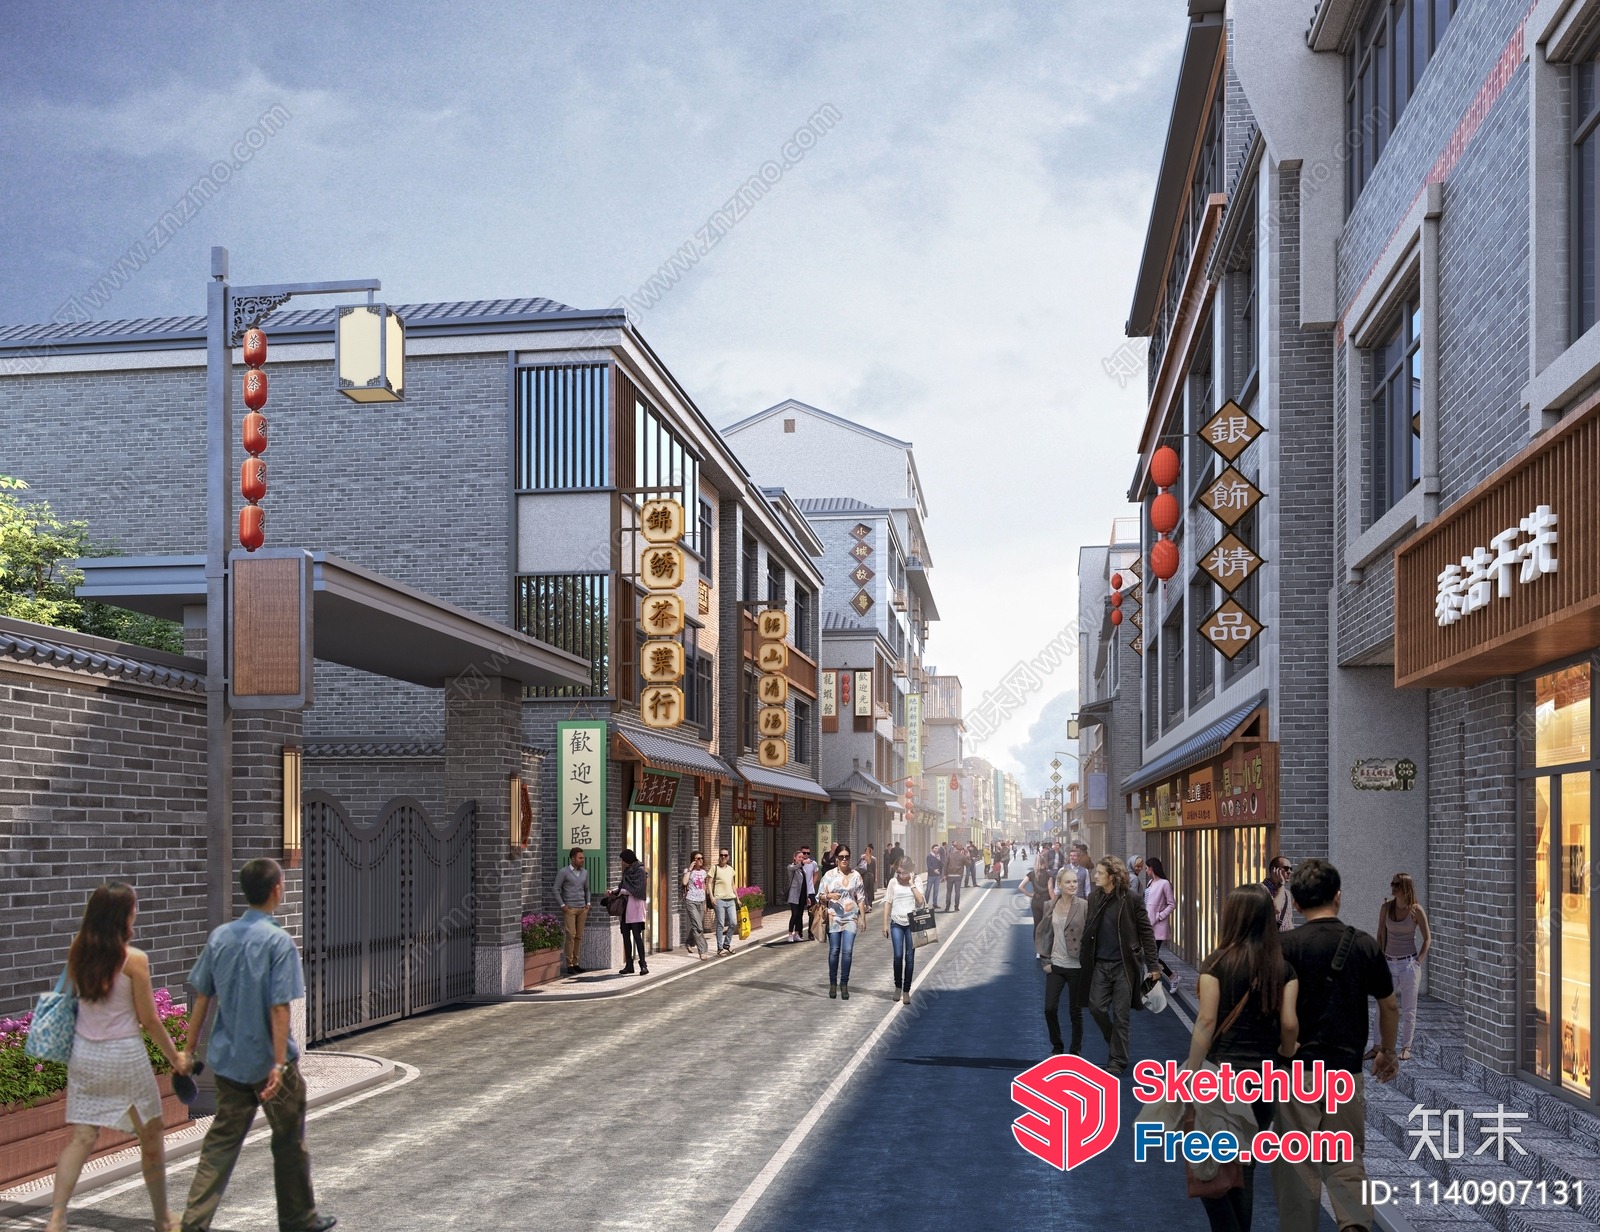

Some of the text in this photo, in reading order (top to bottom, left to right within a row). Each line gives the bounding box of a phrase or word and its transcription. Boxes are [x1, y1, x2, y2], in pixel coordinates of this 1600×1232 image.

[247, 334, 261, 349] 茶
[247, 375, 260, 391] 茶
[1208, 416, 1256, 641] 銀飾精品
[1435, 505, 1558, 627] 泰洁干洗
